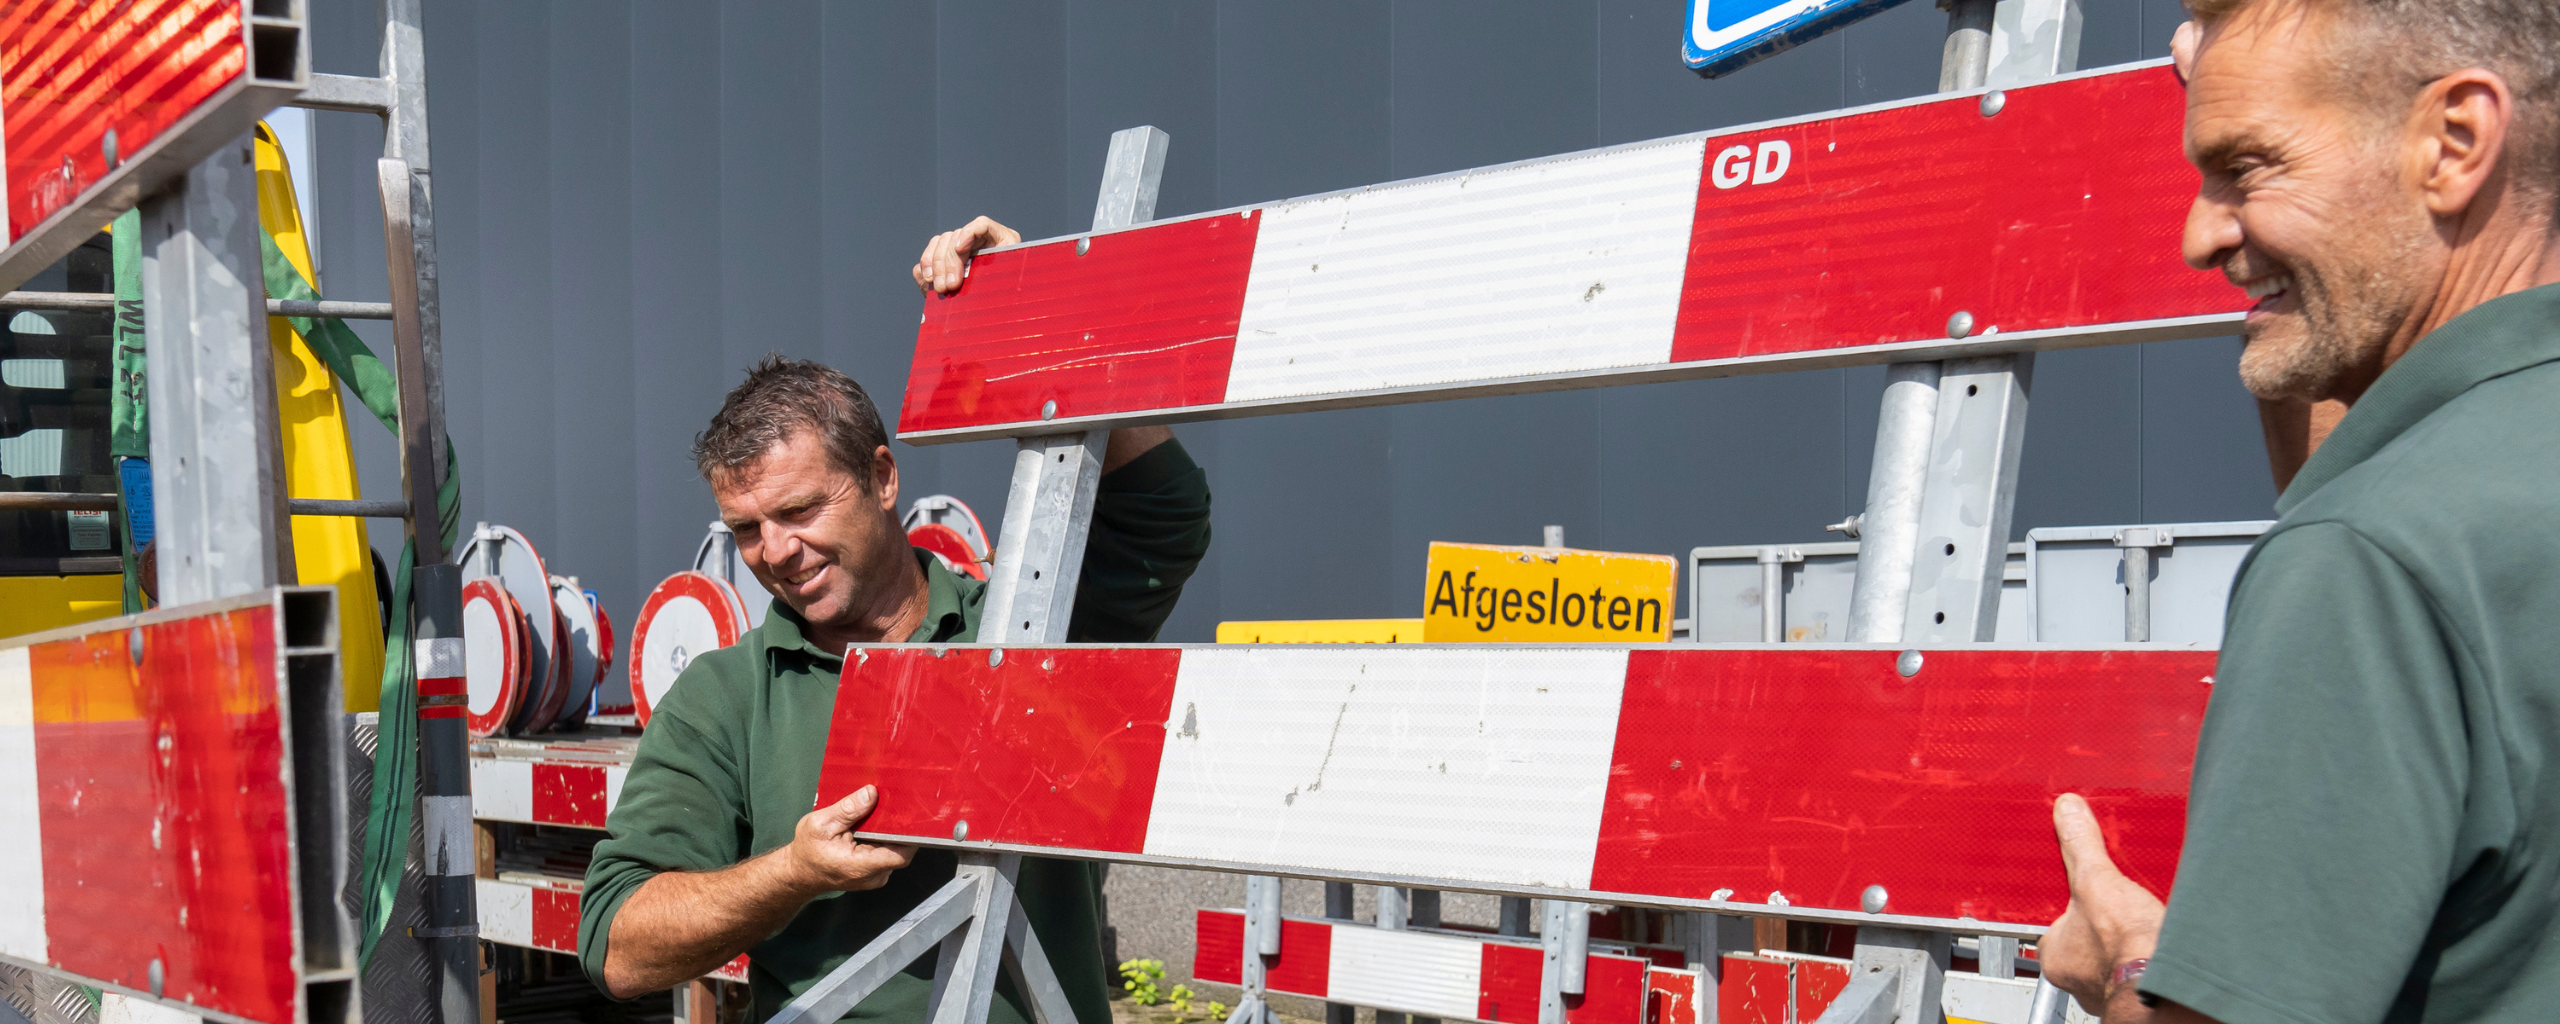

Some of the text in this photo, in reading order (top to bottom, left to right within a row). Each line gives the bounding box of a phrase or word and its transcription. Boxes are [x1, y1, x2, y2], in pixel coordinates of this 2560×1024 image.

[1711, 139, 1792, 190] GD
[118, 299, 146, 361] WLL
[1429, 570, 1662, 634] Afgesloten
